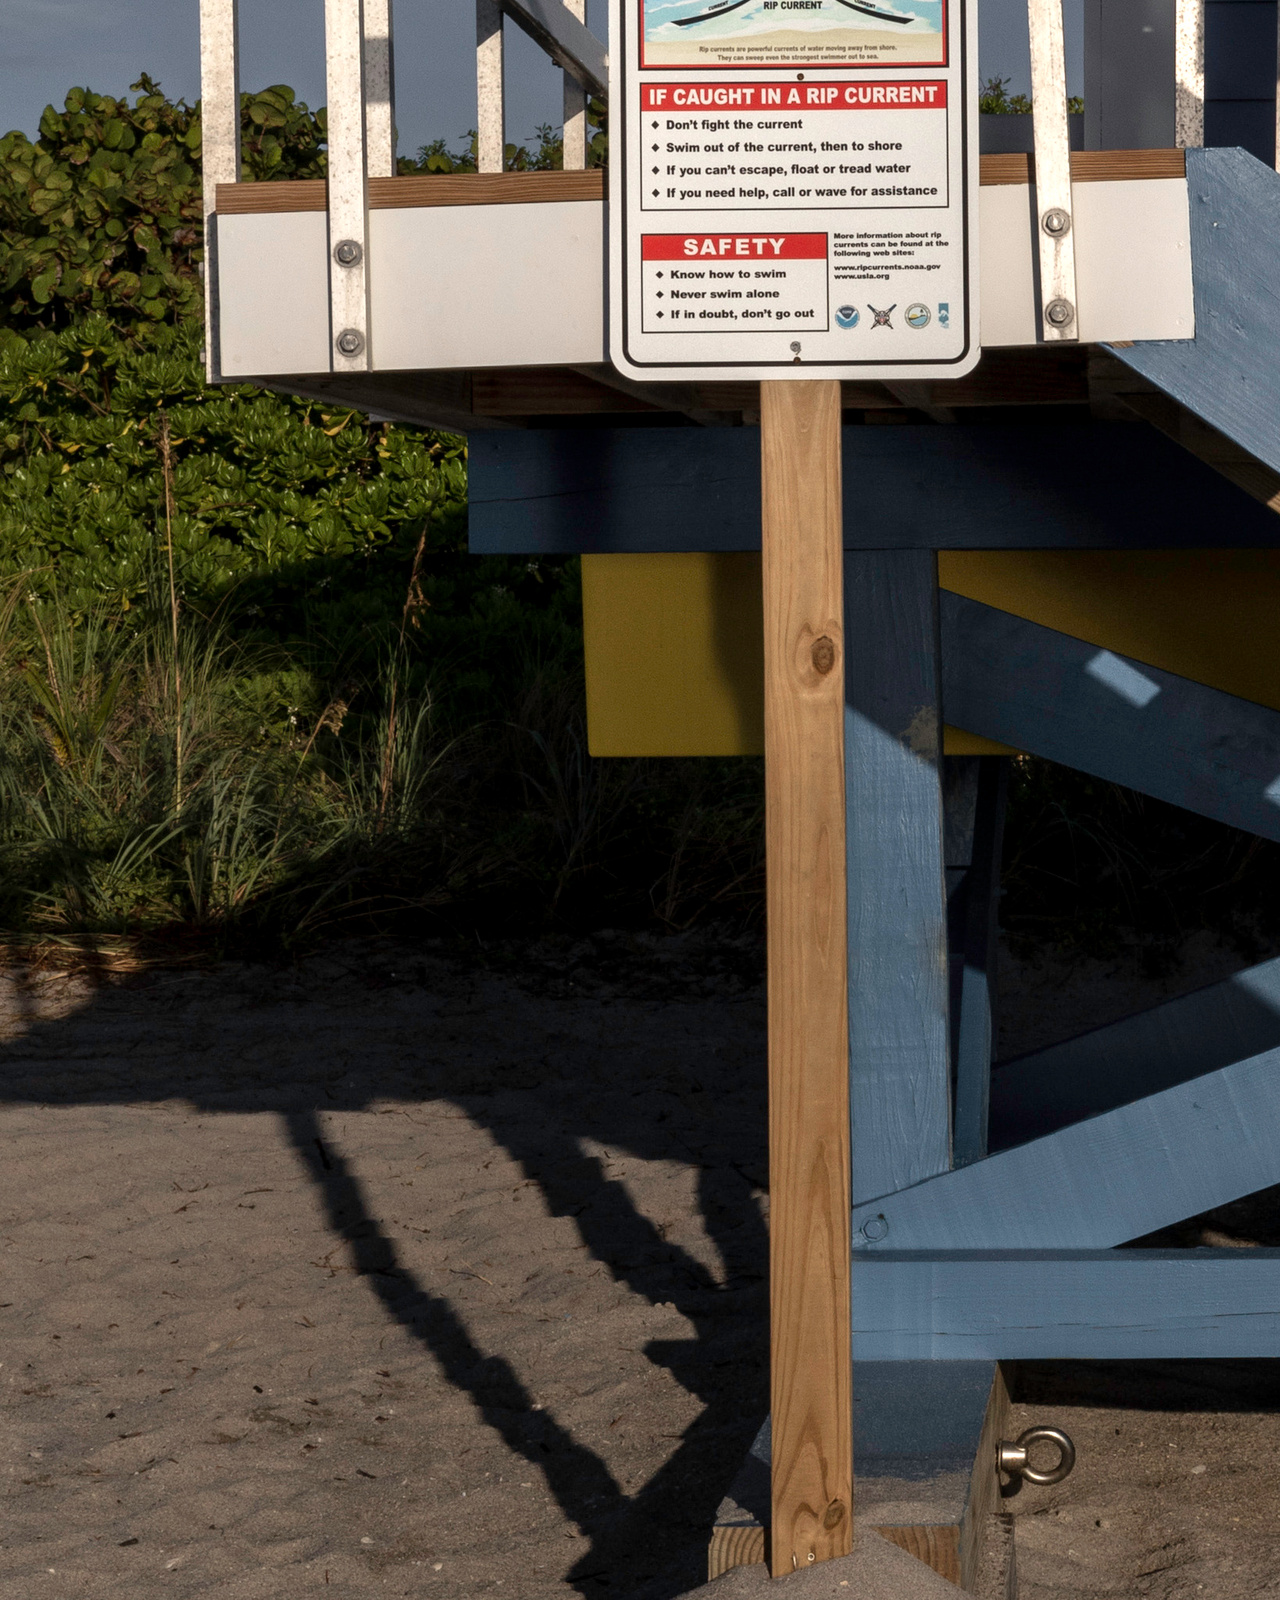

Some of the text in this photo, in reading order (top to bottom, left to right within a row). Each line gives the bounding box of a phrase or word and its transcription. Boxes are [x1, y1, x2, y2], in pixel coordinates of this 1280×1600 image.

[708, 0, 728, 10] CURRENT
[764, 1, 822, 9] RIP CURRENT
[747, 45, 773, 54] powerful
[826, 45, 847, 53] moving
[718, 54, 732, 62] They
[781, 53, 791, 61] the
[650, 86, 937, 105] IF CAUGHT IN A RIP CURRENT
[702, 120, 729, 132] fight
[734, 120, 753, 129] the
[757, 119, 802, 129] current
[667, 141, 902, 153] Swim out of the current, then to shore
[667, 165, 675, 175] If
[680, 168, 701, 177] you
[740, 167, 787, 176] escape,
[791, 164, 819, 174] float
[839, 164, 871, 173] tread
[875, 164, 911, 173] water
[667, 188, 676, 197] If
[680, 190, 701, 200] you
[706, 188, 735, 197] need
[739, 188, 768, 199] help,
[773, 187, 794, 197] call
[851, 186, 867, 196] for
[871, 186, 937, 196] assistance
[931, 231, 942, 239] rip
[684, 238, 785, 255] SAFETY
[834, 264, 941, 272] www.ripcurrents.noaa.gov
[671, 270, 786, 279] Know how to swim
[671, 290, 779, 298] Never swim alone
[671, 310, 680, 318] If
[684, 310, 695, 318] in
[699, 310, 737, 320] doubt,
[776, 311, 790, 320] go
[795, 309, 814, 317] out
